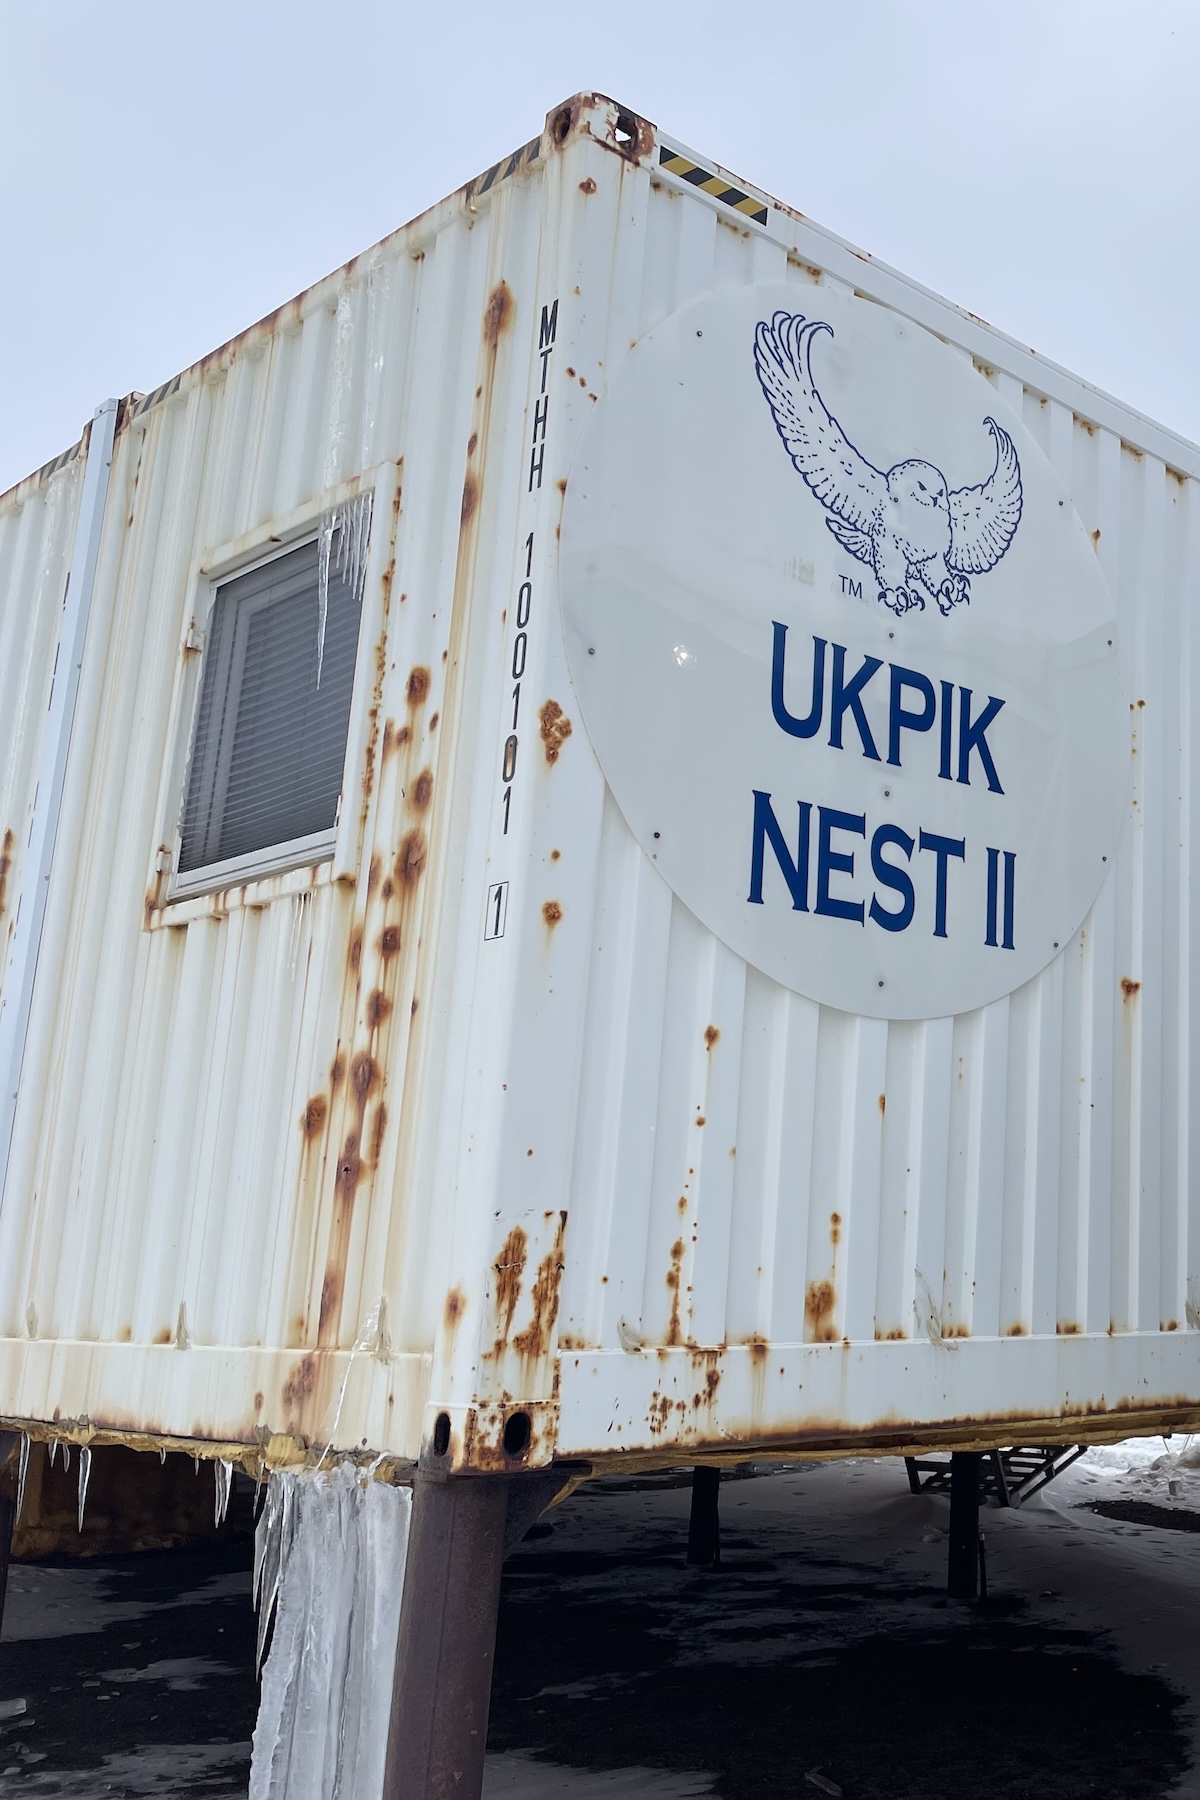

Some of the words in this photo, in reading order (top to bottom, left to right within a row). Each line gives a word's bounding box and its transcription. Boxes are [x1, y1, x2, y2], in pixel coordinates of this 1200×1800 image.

[529, 299, 559, 492] MTHH
[838, 574, 862, 599] TM
[502, 531, 534, 834] 100101
[770, 620, 1006, 795] UKPIK
[747, 790, 966, 938] NEST
[984, 847, 1017, 950] II
